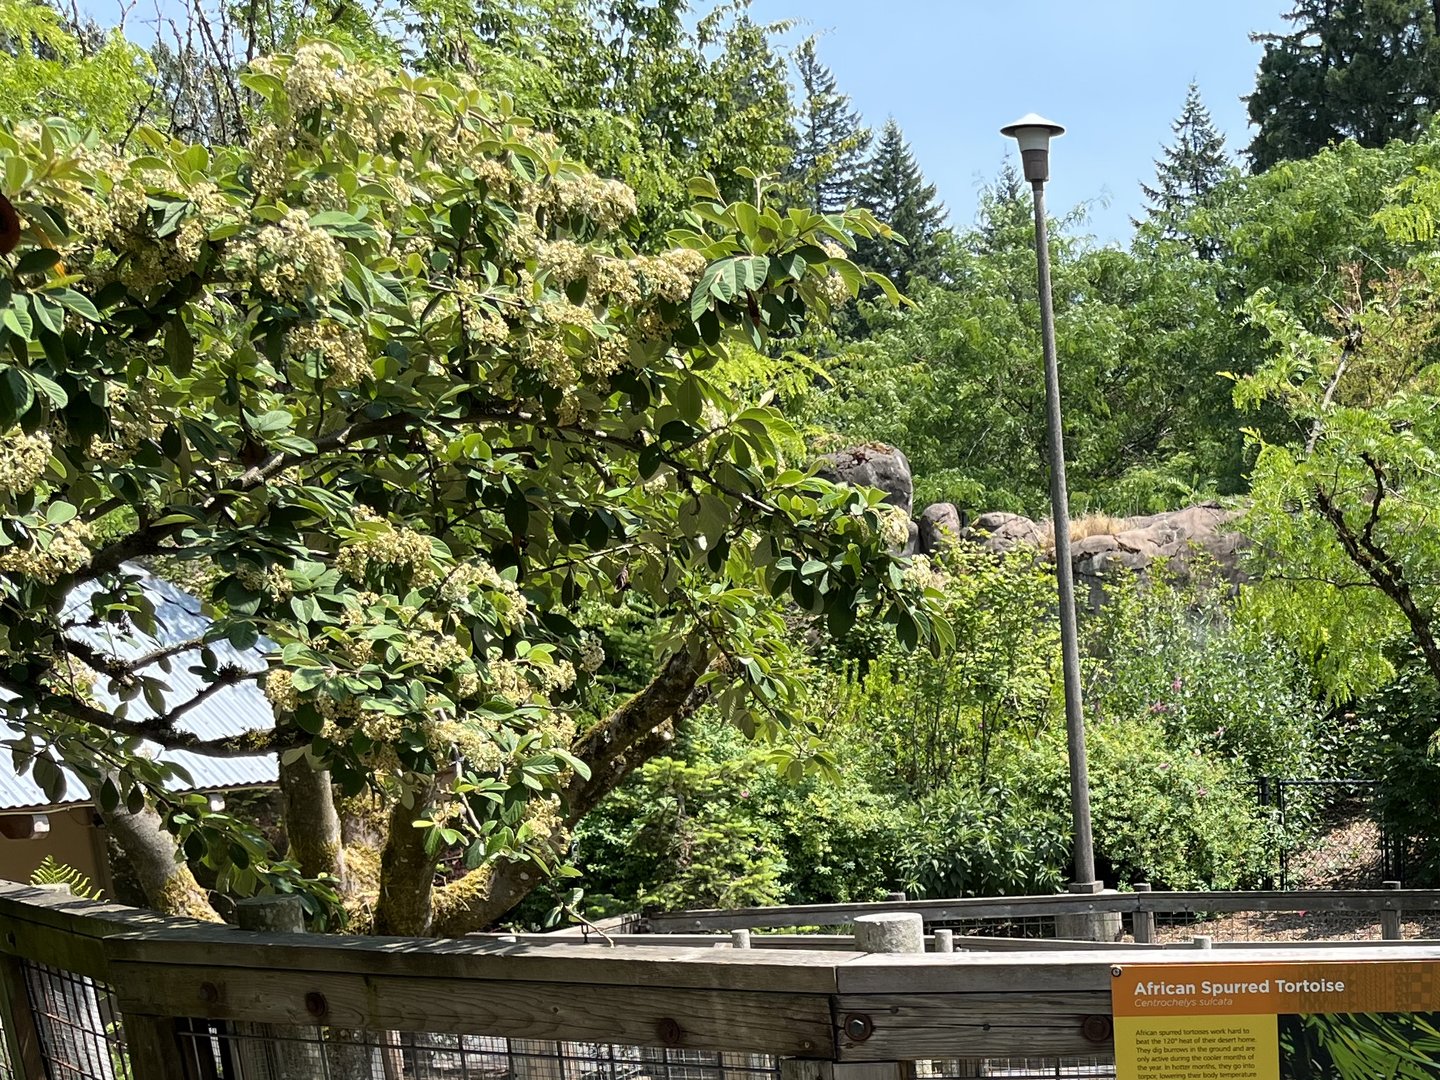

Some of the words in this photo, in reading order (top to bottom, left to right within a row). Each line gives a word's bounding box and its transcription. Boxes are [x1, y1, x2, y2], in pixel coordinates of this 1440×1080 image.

[1134, 982, 1195, 995] African
[1201, 980, 1269, 996] Spurred
[1275, 978, 1344, 993] Tortoise
[1135, 998, 1196, 1007] Centrochelys
[1199, 998, 1232, 1006] sulcata
